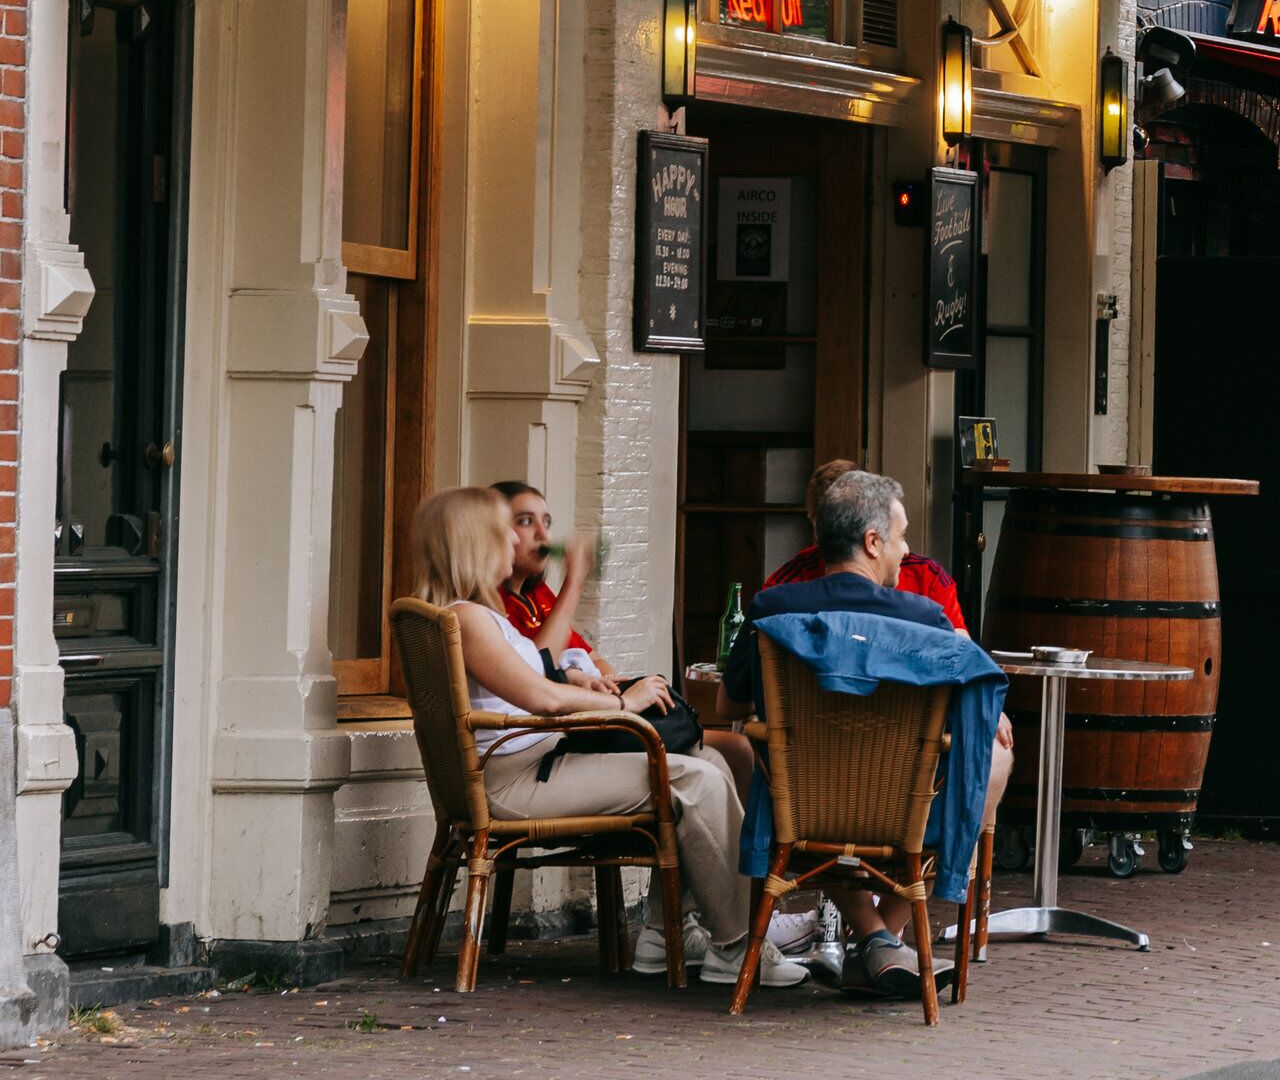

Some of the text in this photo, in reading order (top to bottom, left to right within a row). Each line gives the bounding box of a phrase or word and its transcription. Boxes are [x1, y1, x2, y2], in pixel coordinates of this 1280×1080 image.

[651, 163, 697, 203] HAPPY
[663, 195, 688, 218] HOUR
[737, 190, 776, 202] AIRCO
[935, 189, 955, 217] Live
[737, 211, 778, 224] INSIDE
[934, 207, 972, 246] Football
[657, 228, 675, 241] EVERY
[934, 289, 967, 327] Rugby!
